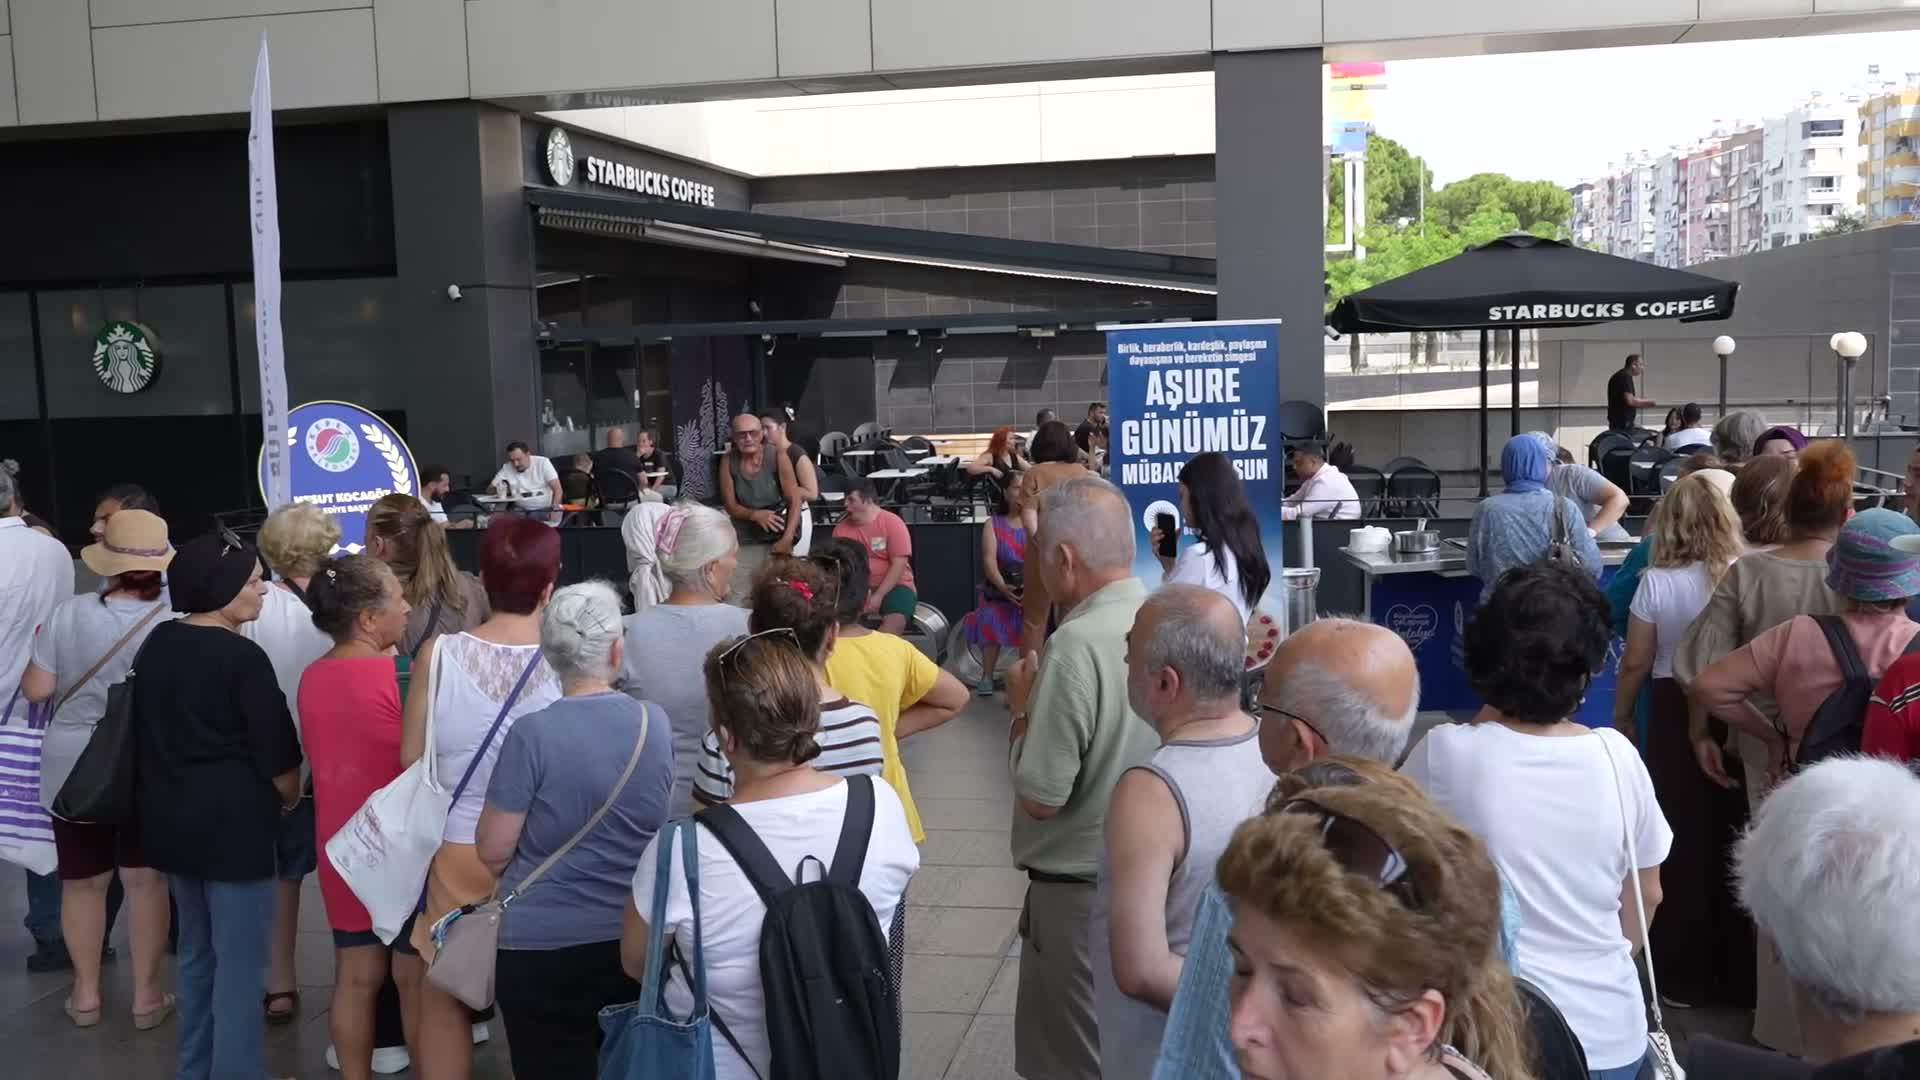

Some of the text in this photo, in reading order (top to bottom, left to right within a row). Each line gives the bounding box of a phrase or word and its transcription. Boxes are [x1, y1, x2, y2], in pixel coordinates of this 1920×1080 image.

[587, 156, 715, 207] STARBUCKS COFFEE
[1489, 295, 1716, 320] STARBUCKS COFFEE
[1174, 355, 1184, 364] ve
[1146, 367, 1241, 411] AŞURE
[1121, 409, 1267, 456] GÜNÜMÜZ
[1232, 458, 1268, 480] SUN
